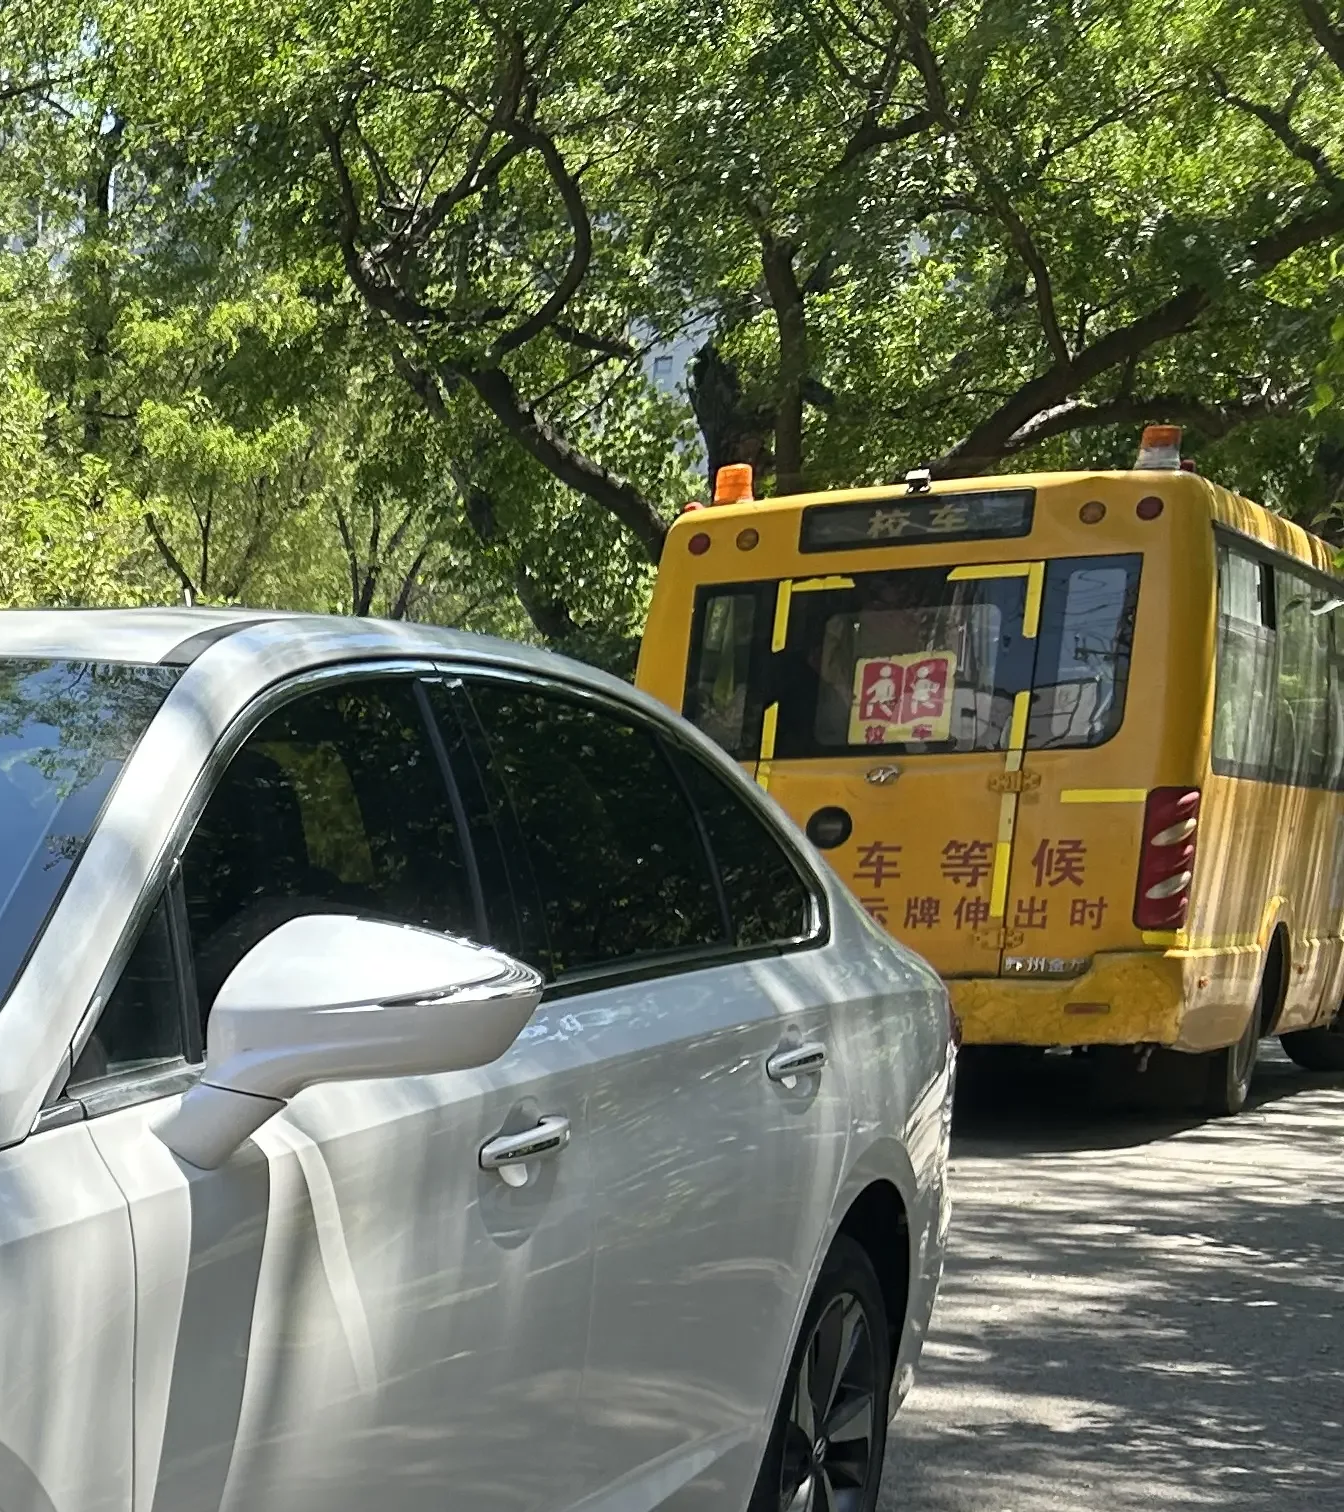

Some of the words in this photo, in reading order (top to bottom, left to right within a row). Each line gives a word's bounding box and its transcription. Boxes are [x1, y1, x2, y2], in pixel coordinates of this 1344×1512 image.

[866, 503, 969, 539] 校车
[853, 838, 1087, 888] 车等候
